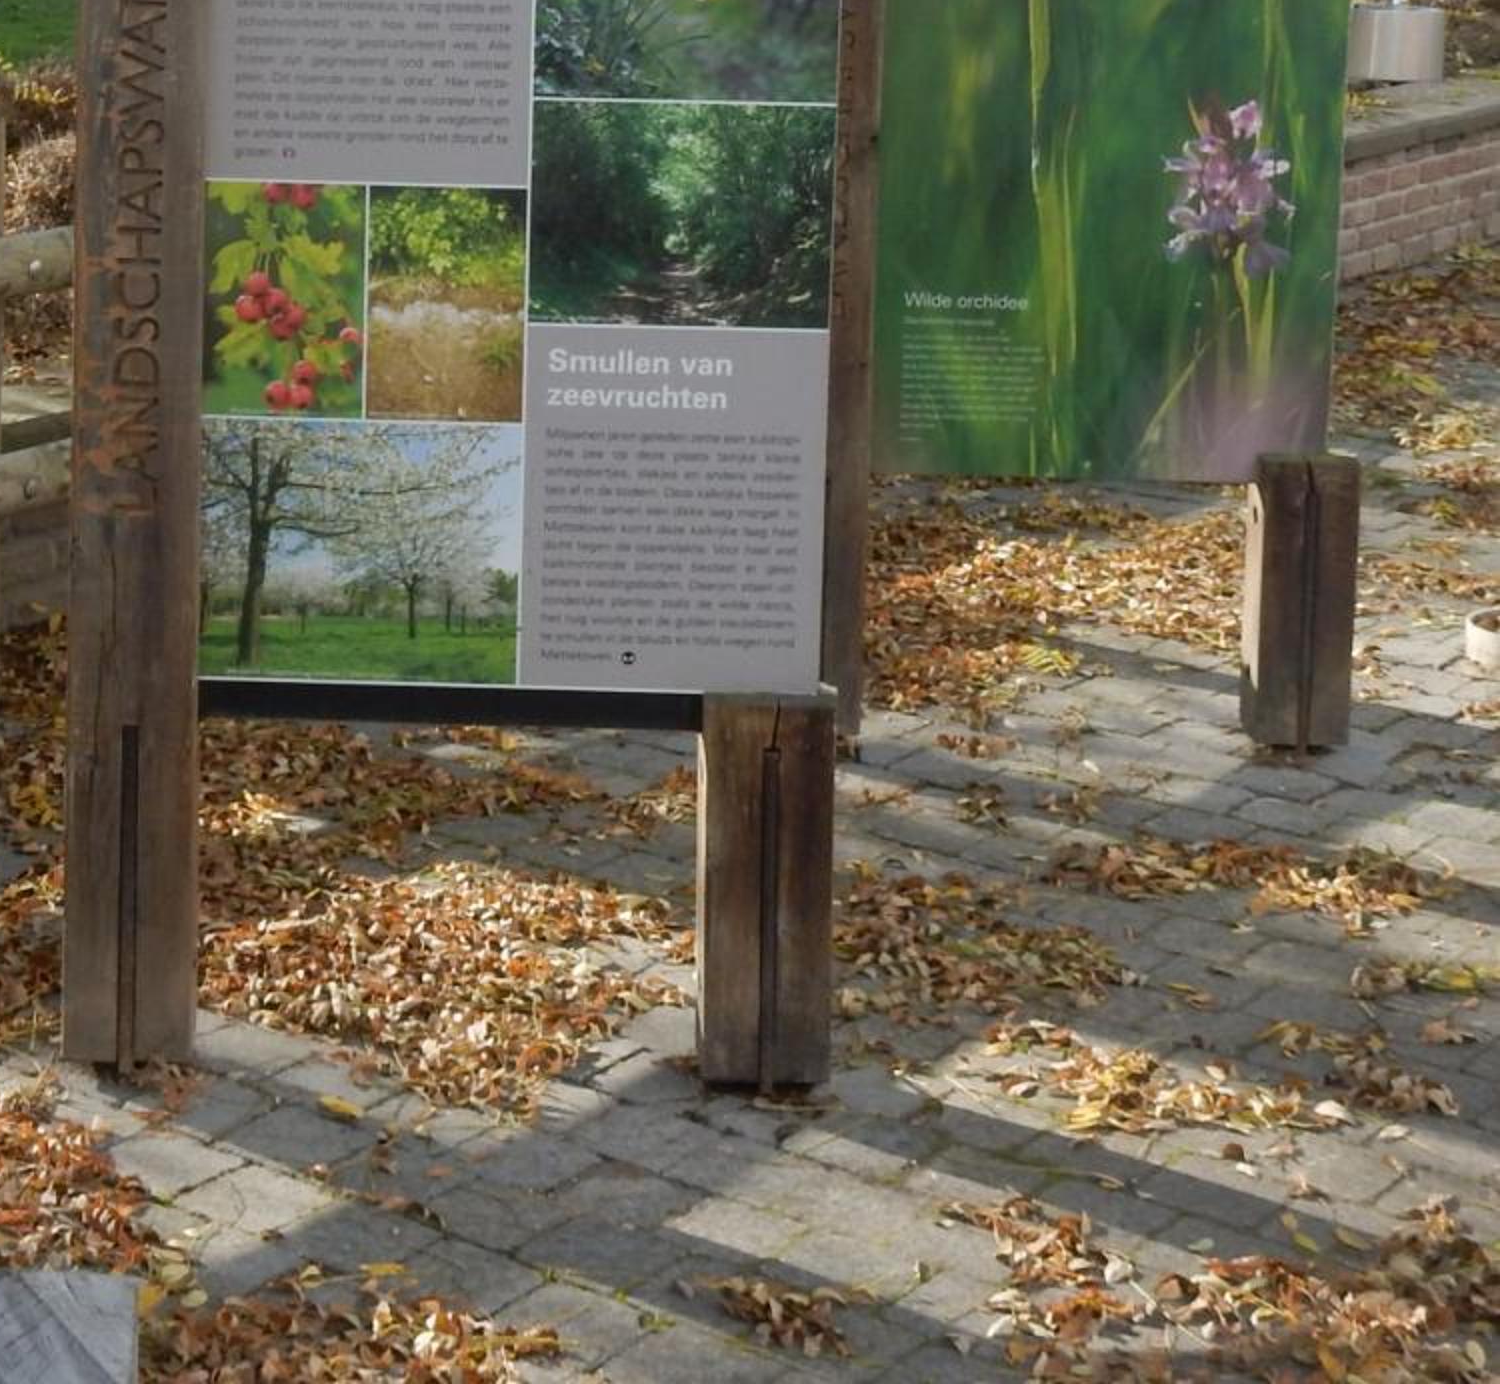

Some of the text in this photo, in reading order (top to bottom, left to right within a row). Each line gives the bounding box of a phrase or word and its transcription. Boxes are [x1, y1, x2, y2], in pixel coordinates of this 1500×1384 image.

[904, 291, 953, 309] Wilde
[547, 347, 734, 377] Smullen van
[547, 384, 728, 410] zeevruchten
